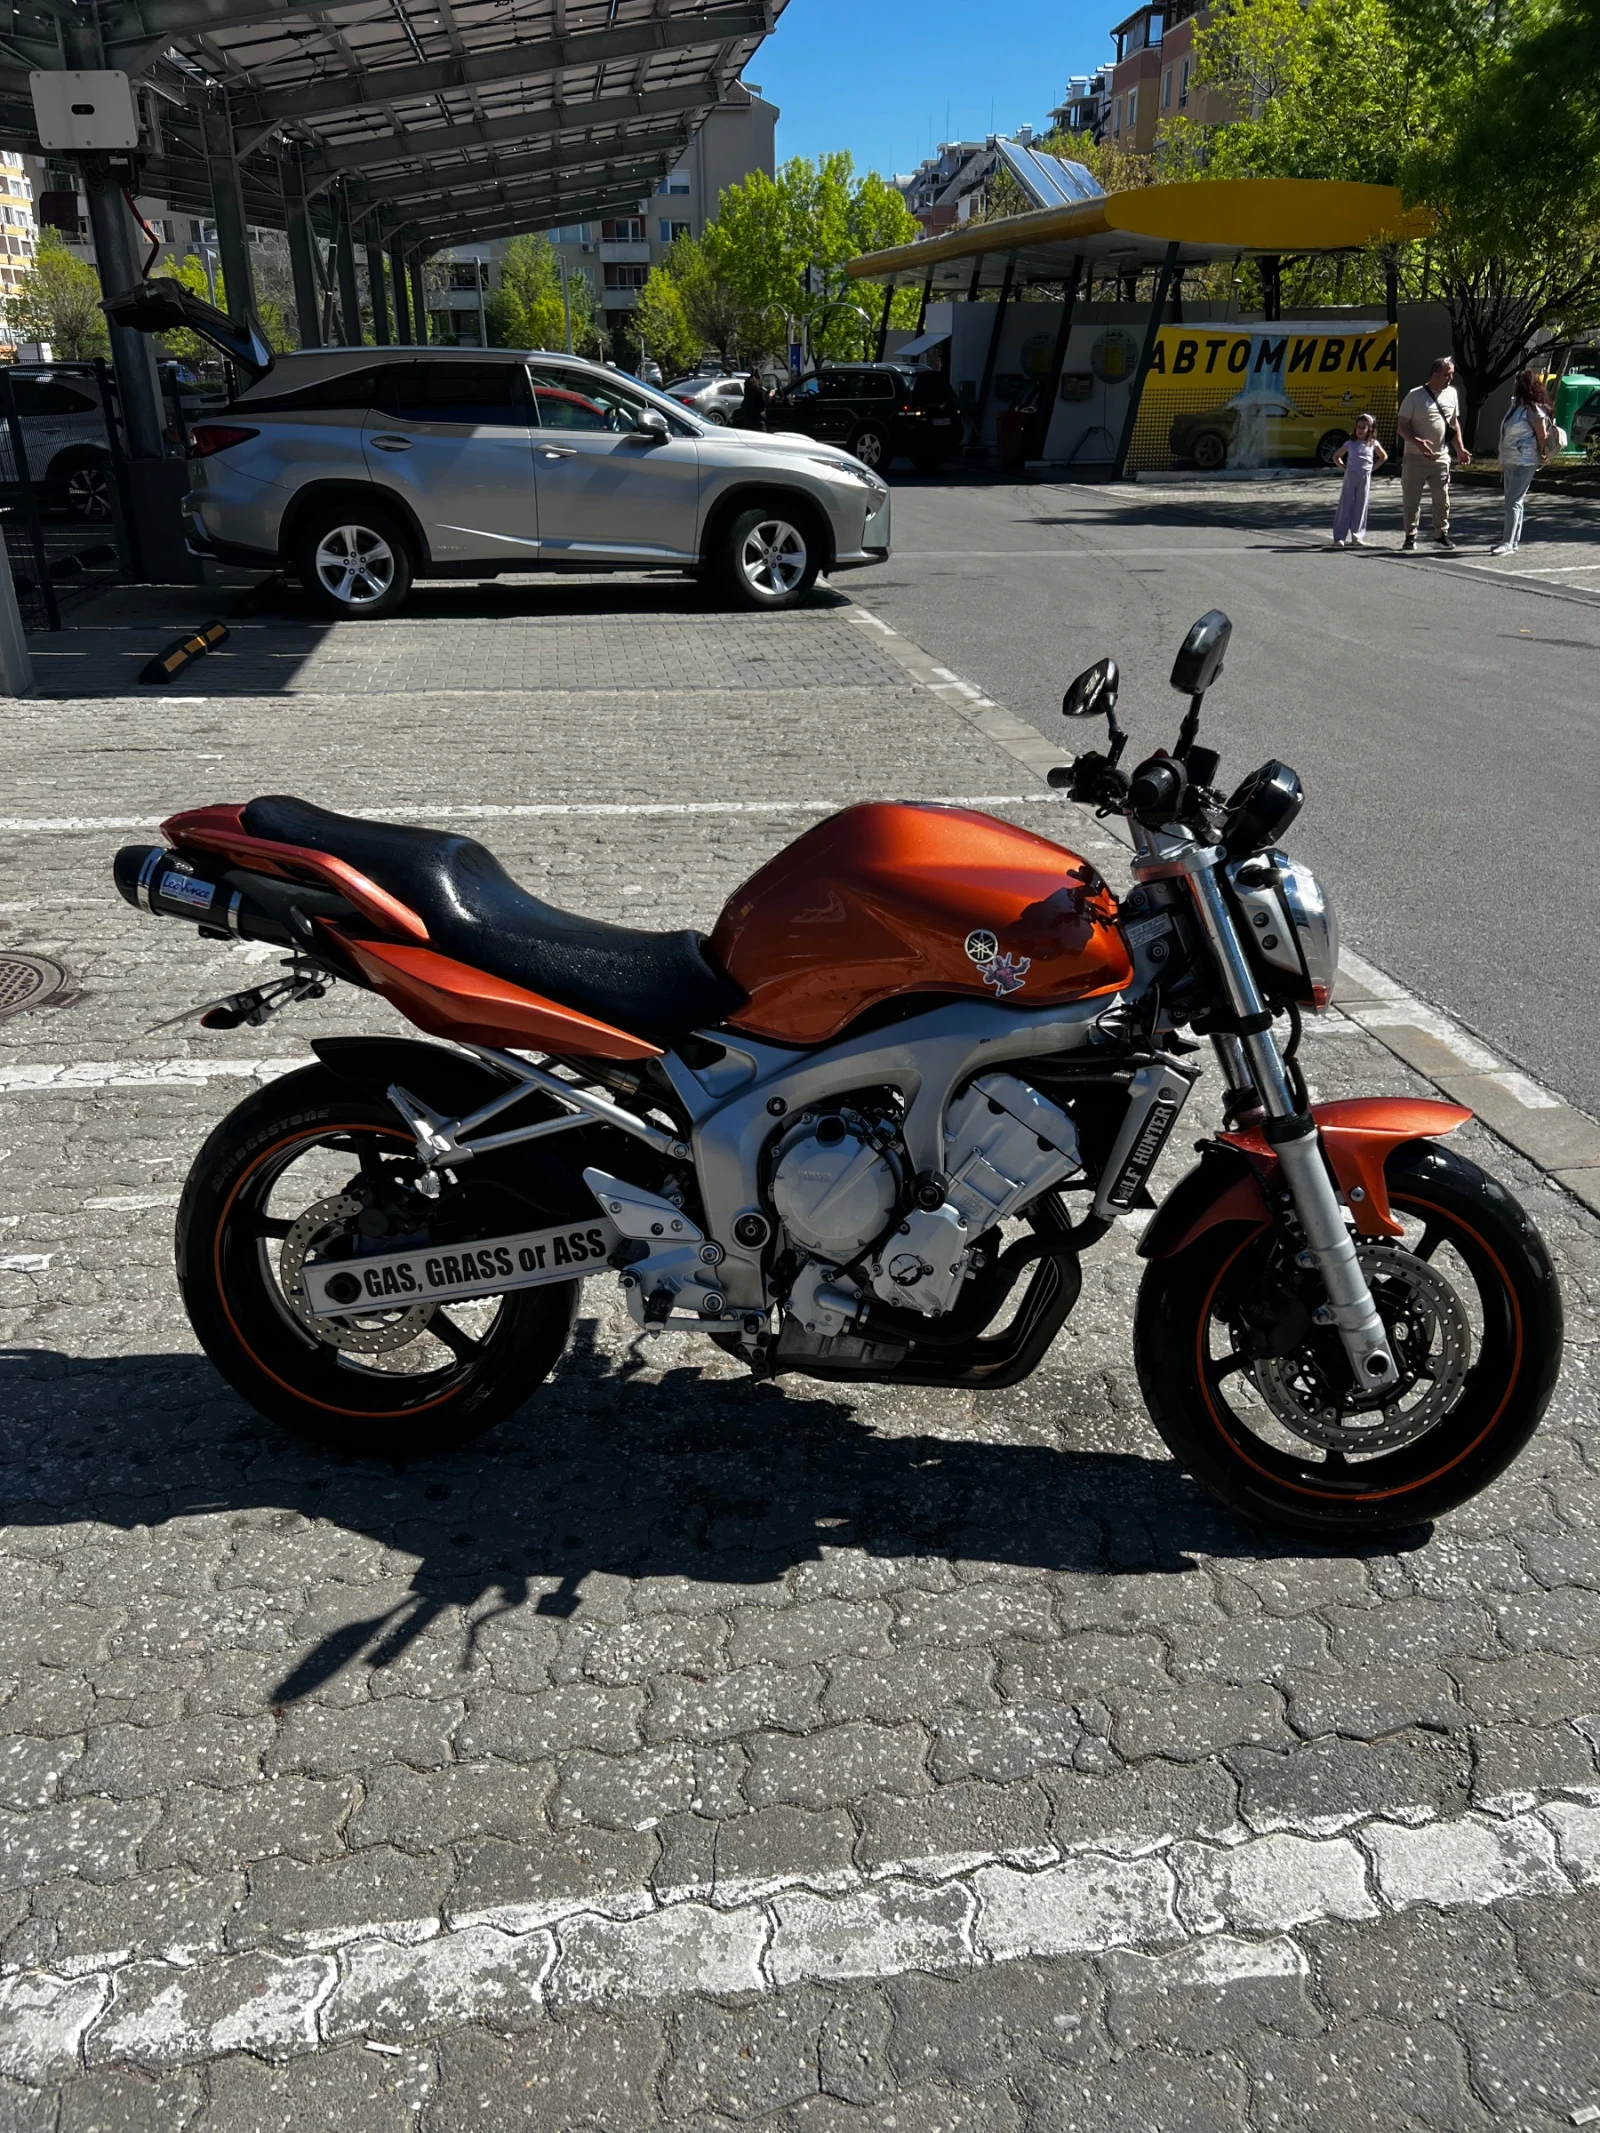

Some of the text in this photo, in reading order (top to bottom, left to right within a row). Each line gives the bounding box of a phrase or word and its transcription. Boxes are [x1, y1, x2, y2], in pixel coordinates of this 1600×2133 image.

[1148, 338, 1397, 375] АВТОМИВКА
[163, 874, 210, 898] LeoVince
[1132, 1107, 1173, 1165] HUNTER
[363, 1228, 607, 1298] GAS, GRASS or ASS
